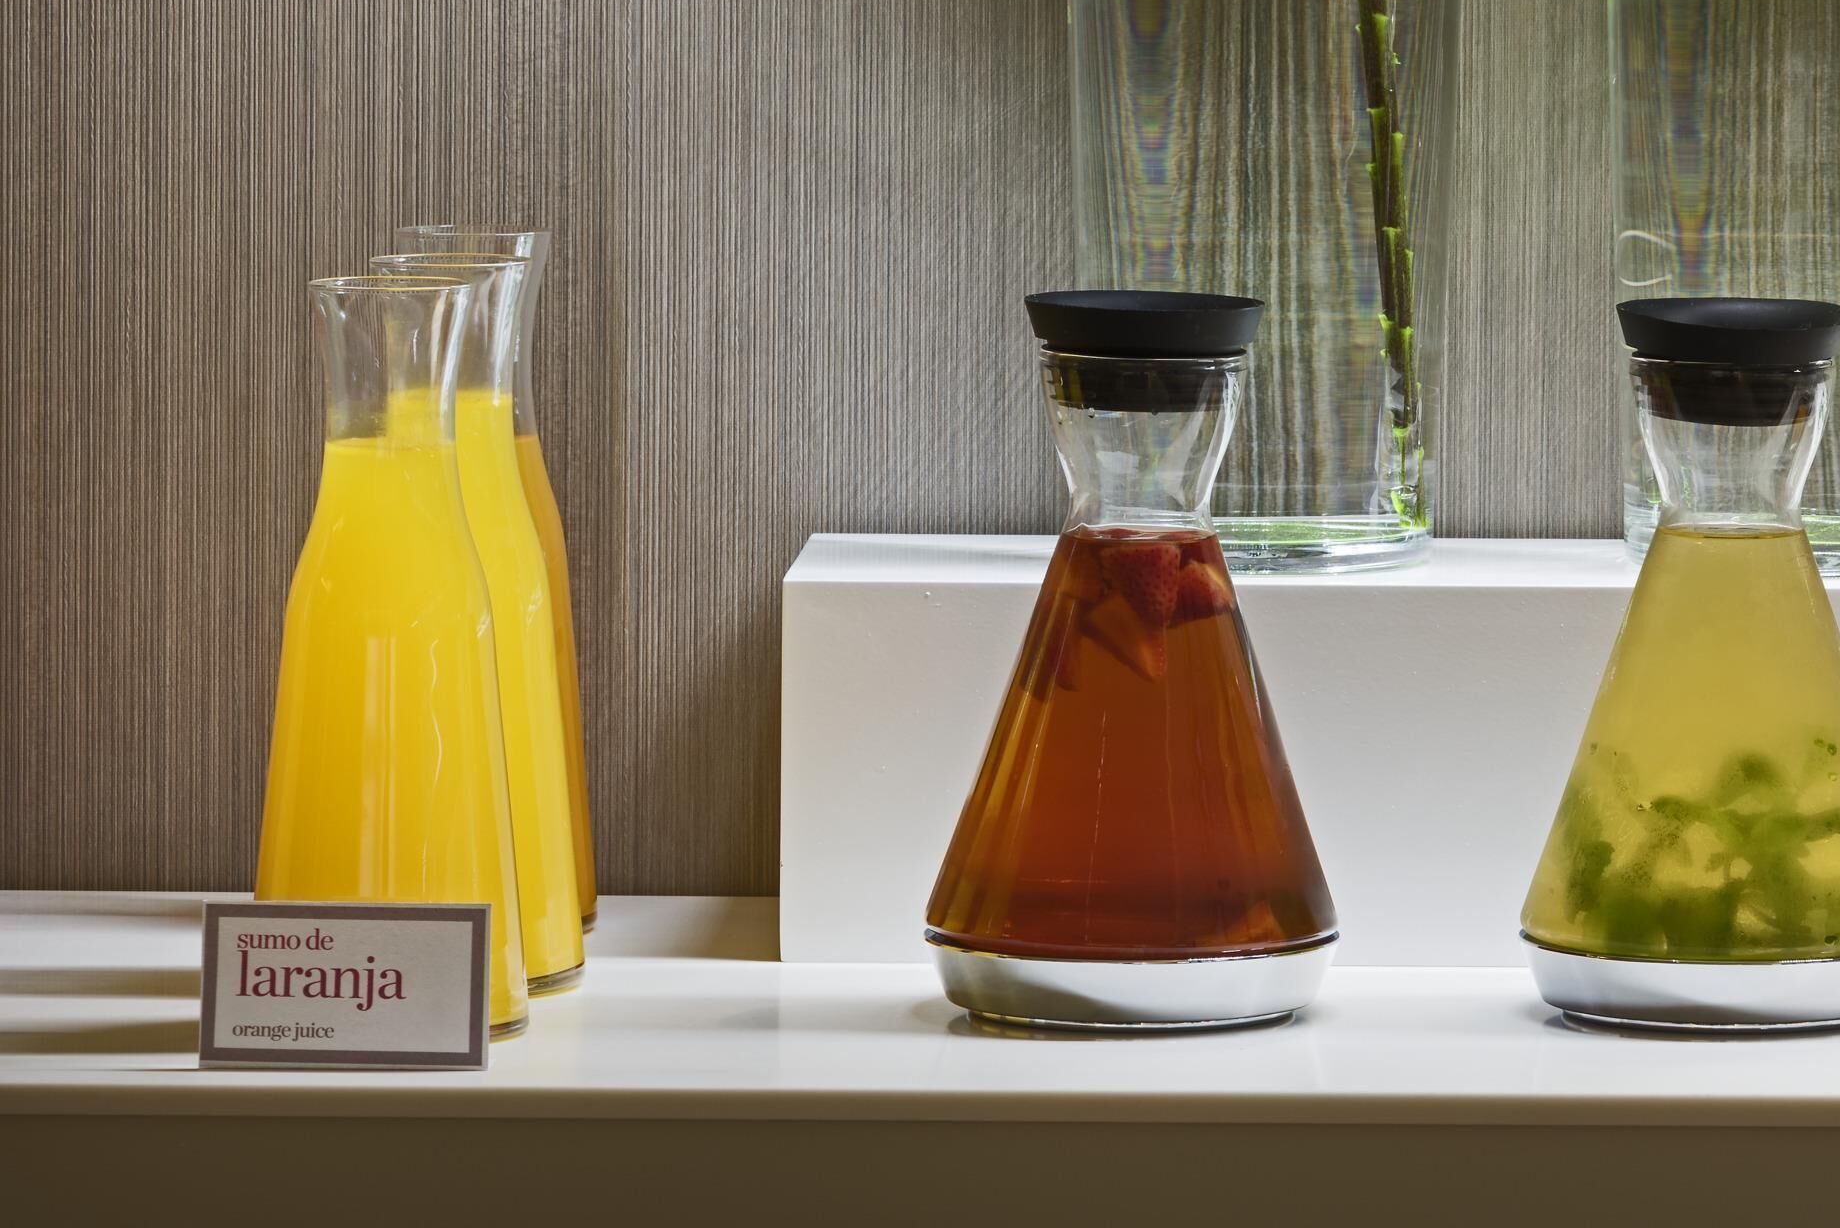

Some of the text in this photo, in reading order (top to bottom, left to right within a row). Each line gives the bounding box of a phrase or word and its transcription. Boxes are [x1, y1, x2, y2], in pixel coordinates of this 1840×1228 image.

[237, 928, 334, 950] sumo de
[235, 949, 407, 1012] laranja
[232, 1022, 335, 1042] orange juice
